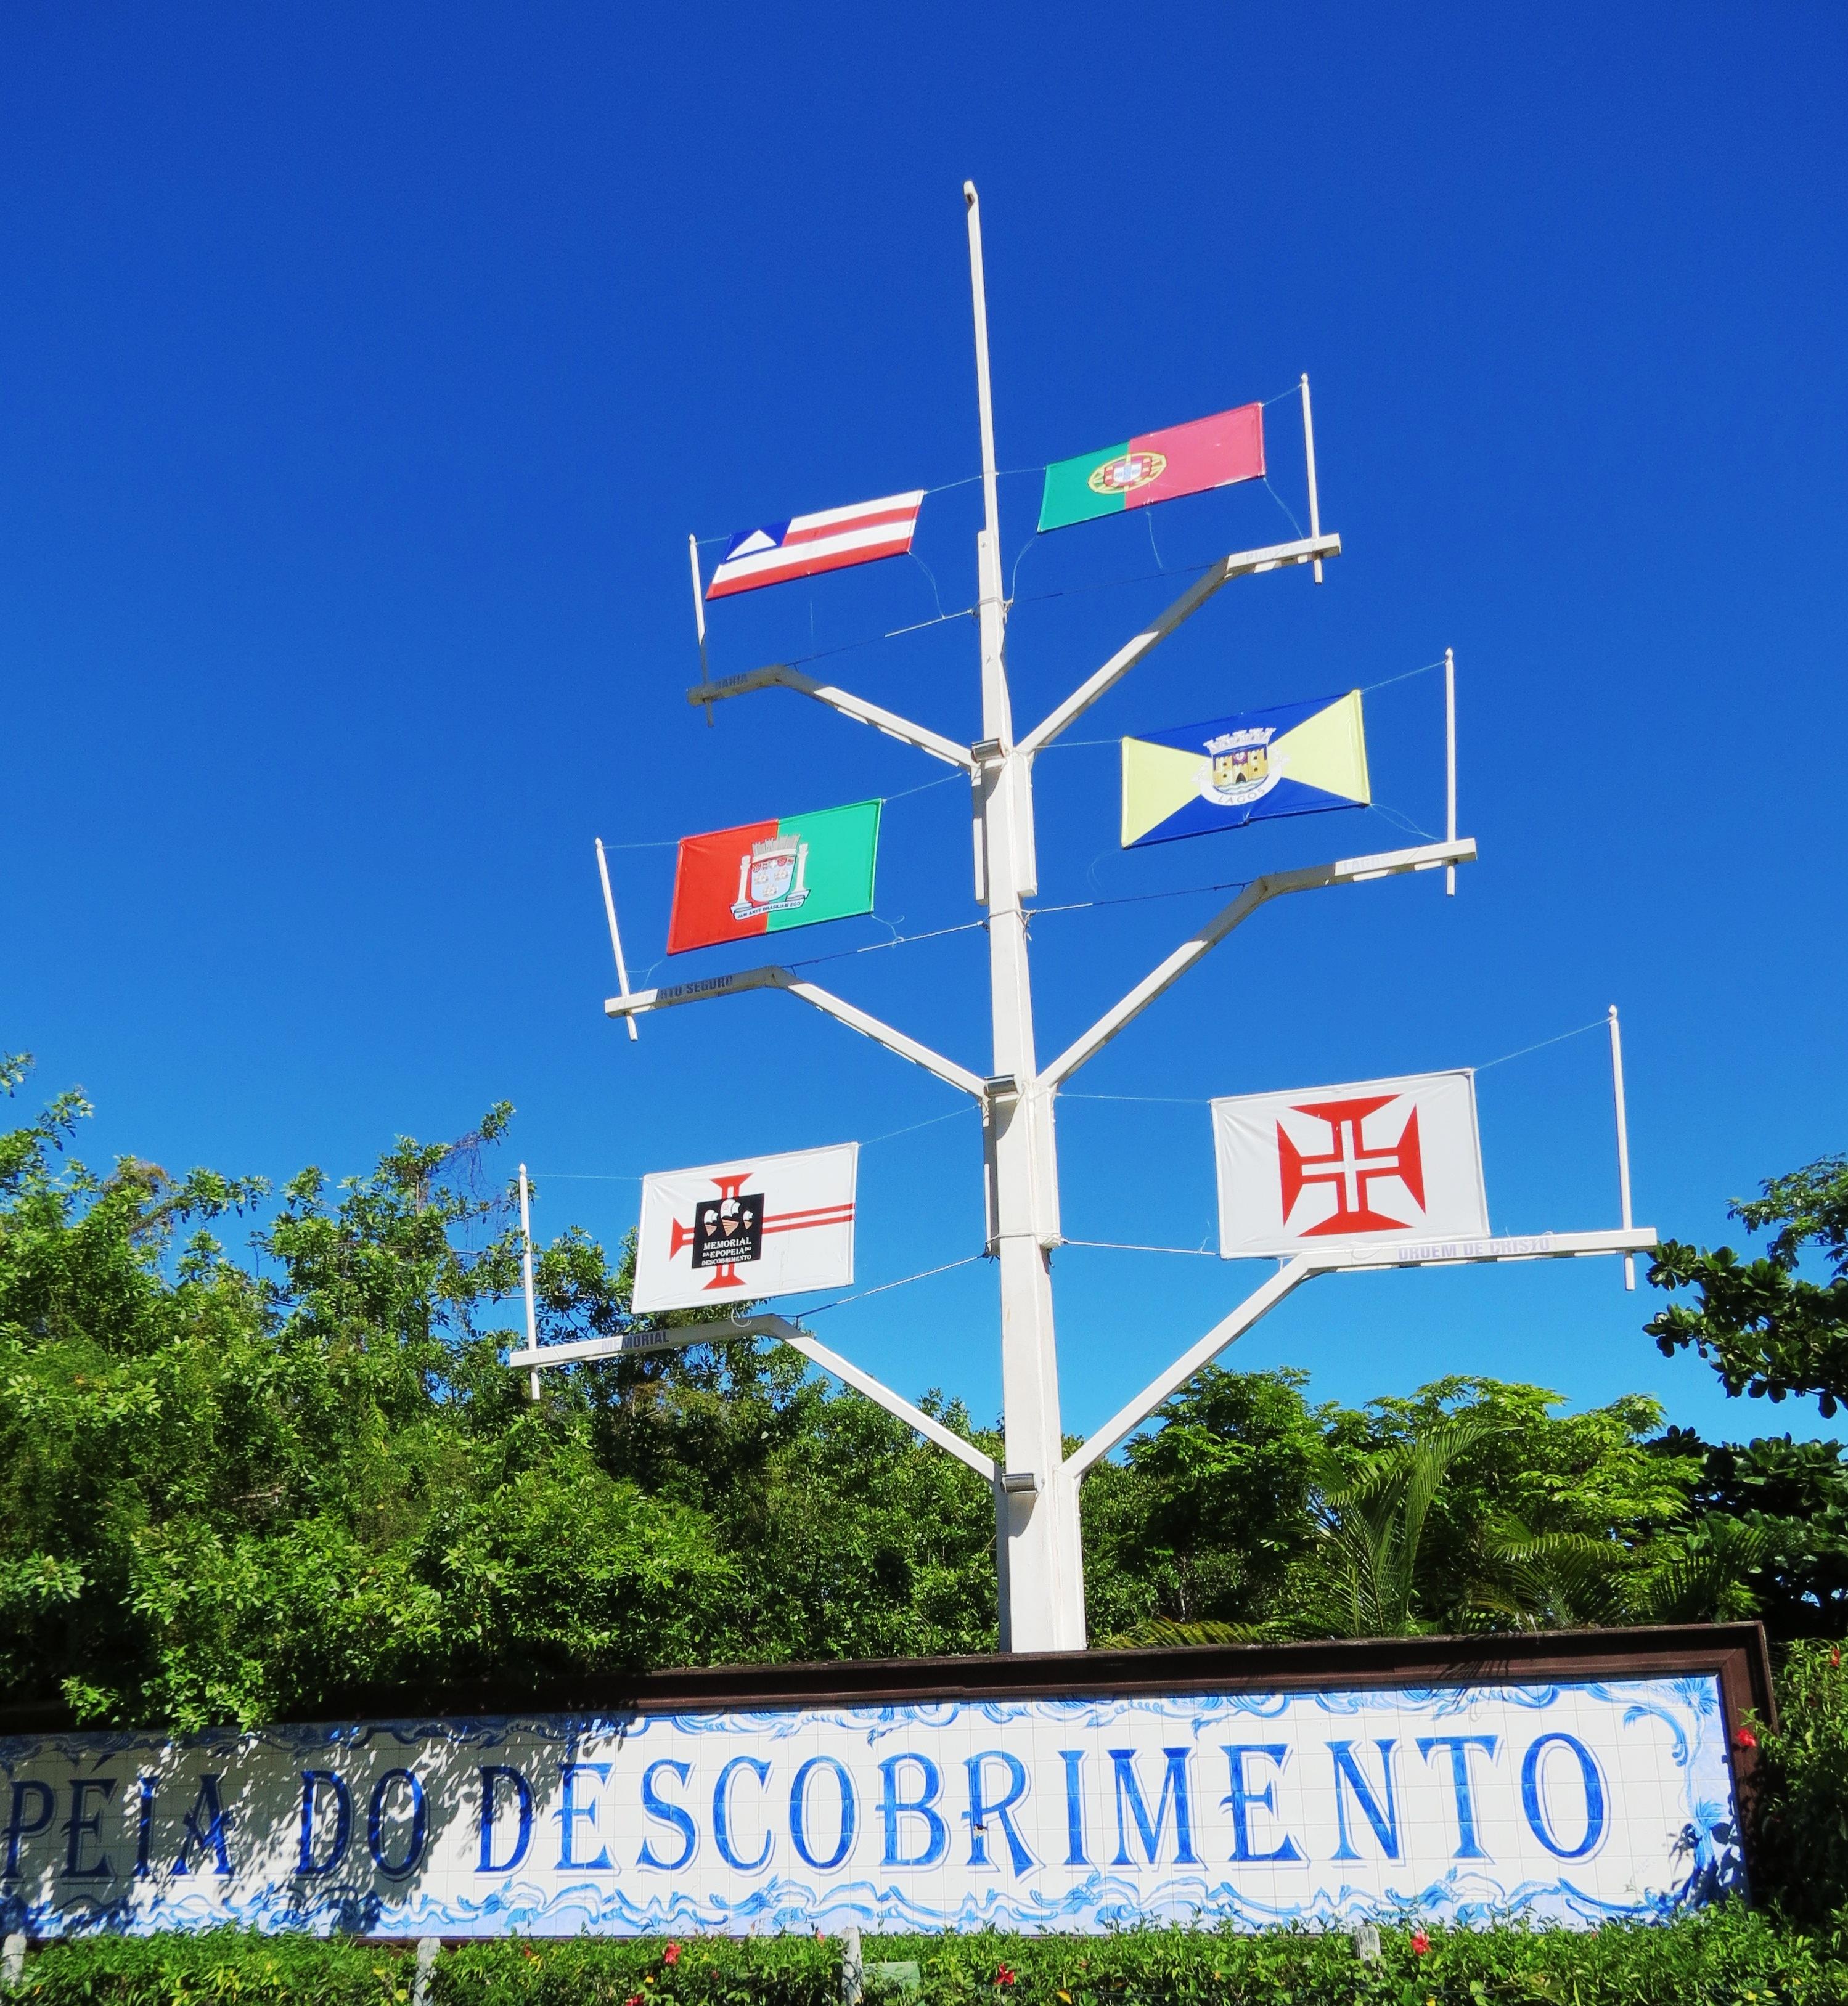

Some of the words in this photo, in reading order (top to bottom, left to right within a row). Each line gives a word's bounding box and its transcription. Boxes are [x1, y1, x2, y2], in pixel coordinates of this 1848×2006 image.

[1217, 789, 1264, 804] LAGOS
[686, 975, 733, 994] SEGURO
[703, 1237, 751, 1250] MEMORIAL
[1398, 1244, 1457, 1260] ORDEM
[1463, 1243, 1484, 1255] DE
[1489, 1237, 1550, 1254] CRISTO
[701, 1254, 751, 1266] DESCOBRIMENTO
[710, 1247, 745, 1258] EPOPEIA
[602, 1331, 669, 1353] MEMORIAL
[294, 1767, 430, 1879] DO
[474, 1732, 1608, 1879] DESCOBRIMENTO
